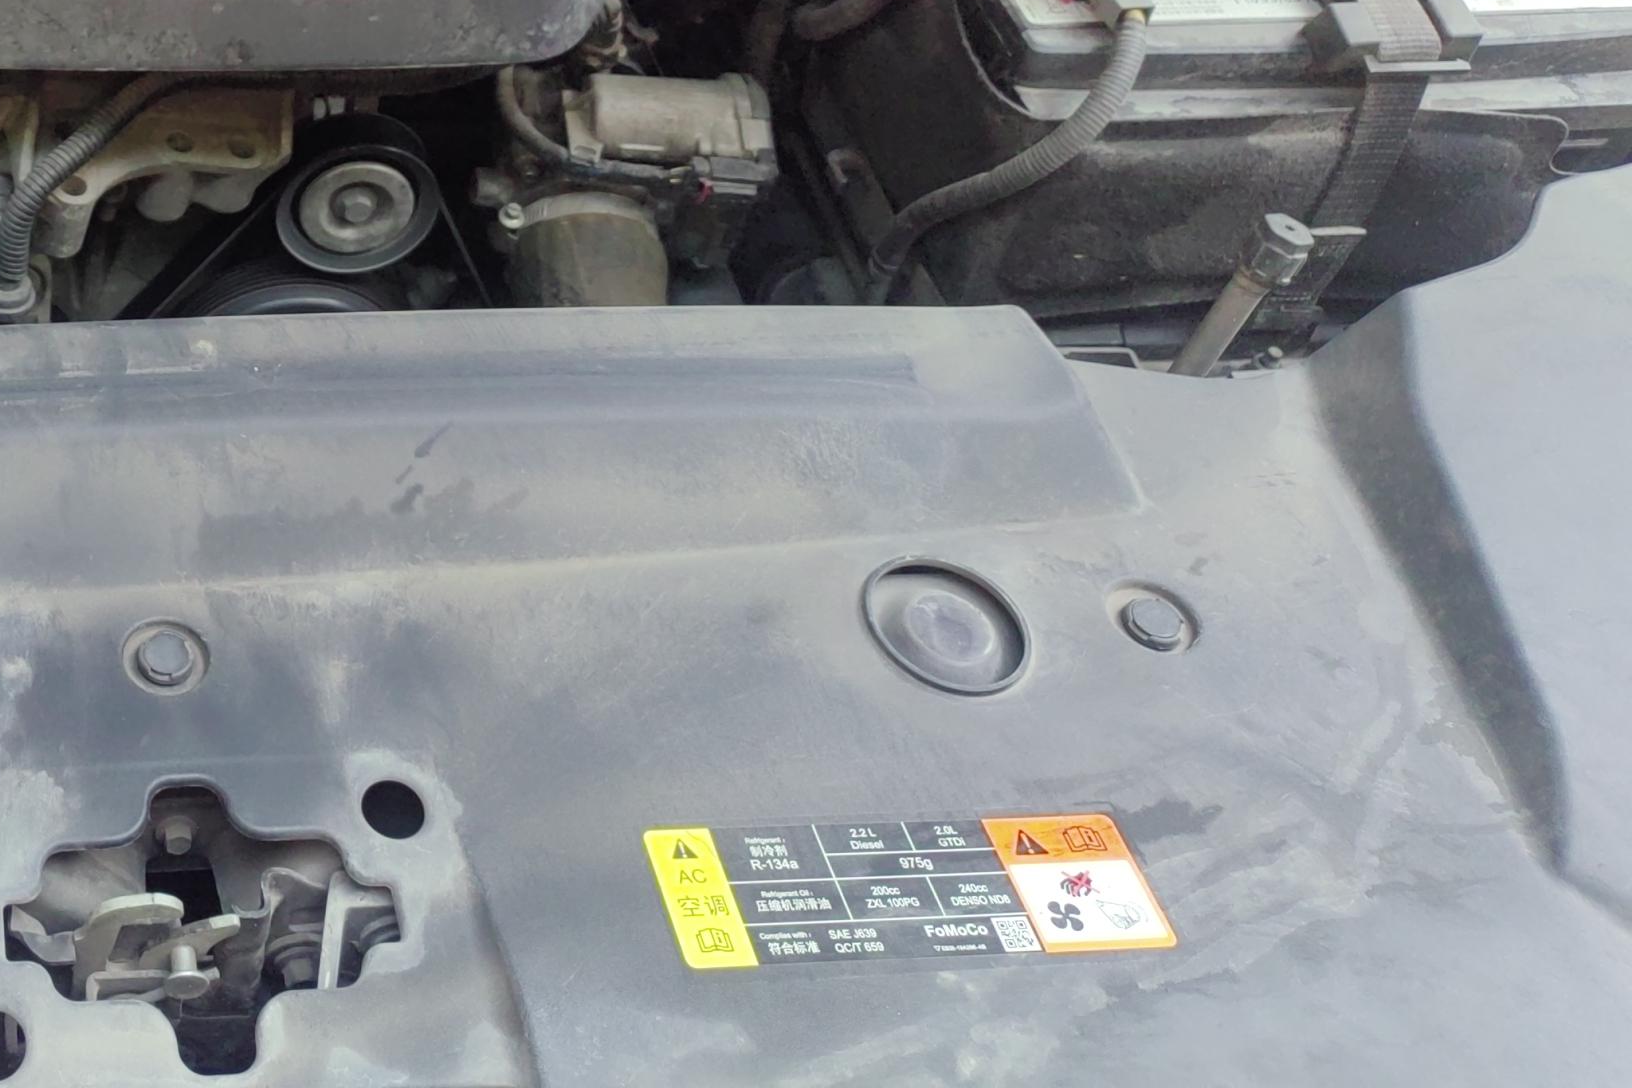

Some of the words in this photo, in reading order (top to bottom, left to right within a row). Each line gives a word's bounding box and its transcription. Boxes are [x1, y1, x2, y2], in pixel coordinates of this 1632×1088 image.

[933, 825, 958, 835] 2.0L
[850, 840, 884, 850] Diesel
[938, 837, 966, 847] GTDi
[749, 844, 788, 857] 制冷剂
[750, 858, 799, 871] R-134a
[899, 857, 934, 871] 975g
[680, 868, 707, 884] AC
[870, 886, 900, 896] 200cc
[958, 883, 988, 893] 240cc
[677, 895, 730, 917] 空调
[755, 897, 832, 912] 压缩机润滑油
[887, 897, 920, 908] 100PG
[950, 895, 988, 906] DENSO
[828, 928, 852, 940] SAE
[853, 927, 877, 939] J639
[923, 923, 988, 937] FoMoCo
[768, 940, 821, 956] 符合标准
[834, 942, 862, 953] QC/T
[863, 941, 884, 952] 659
